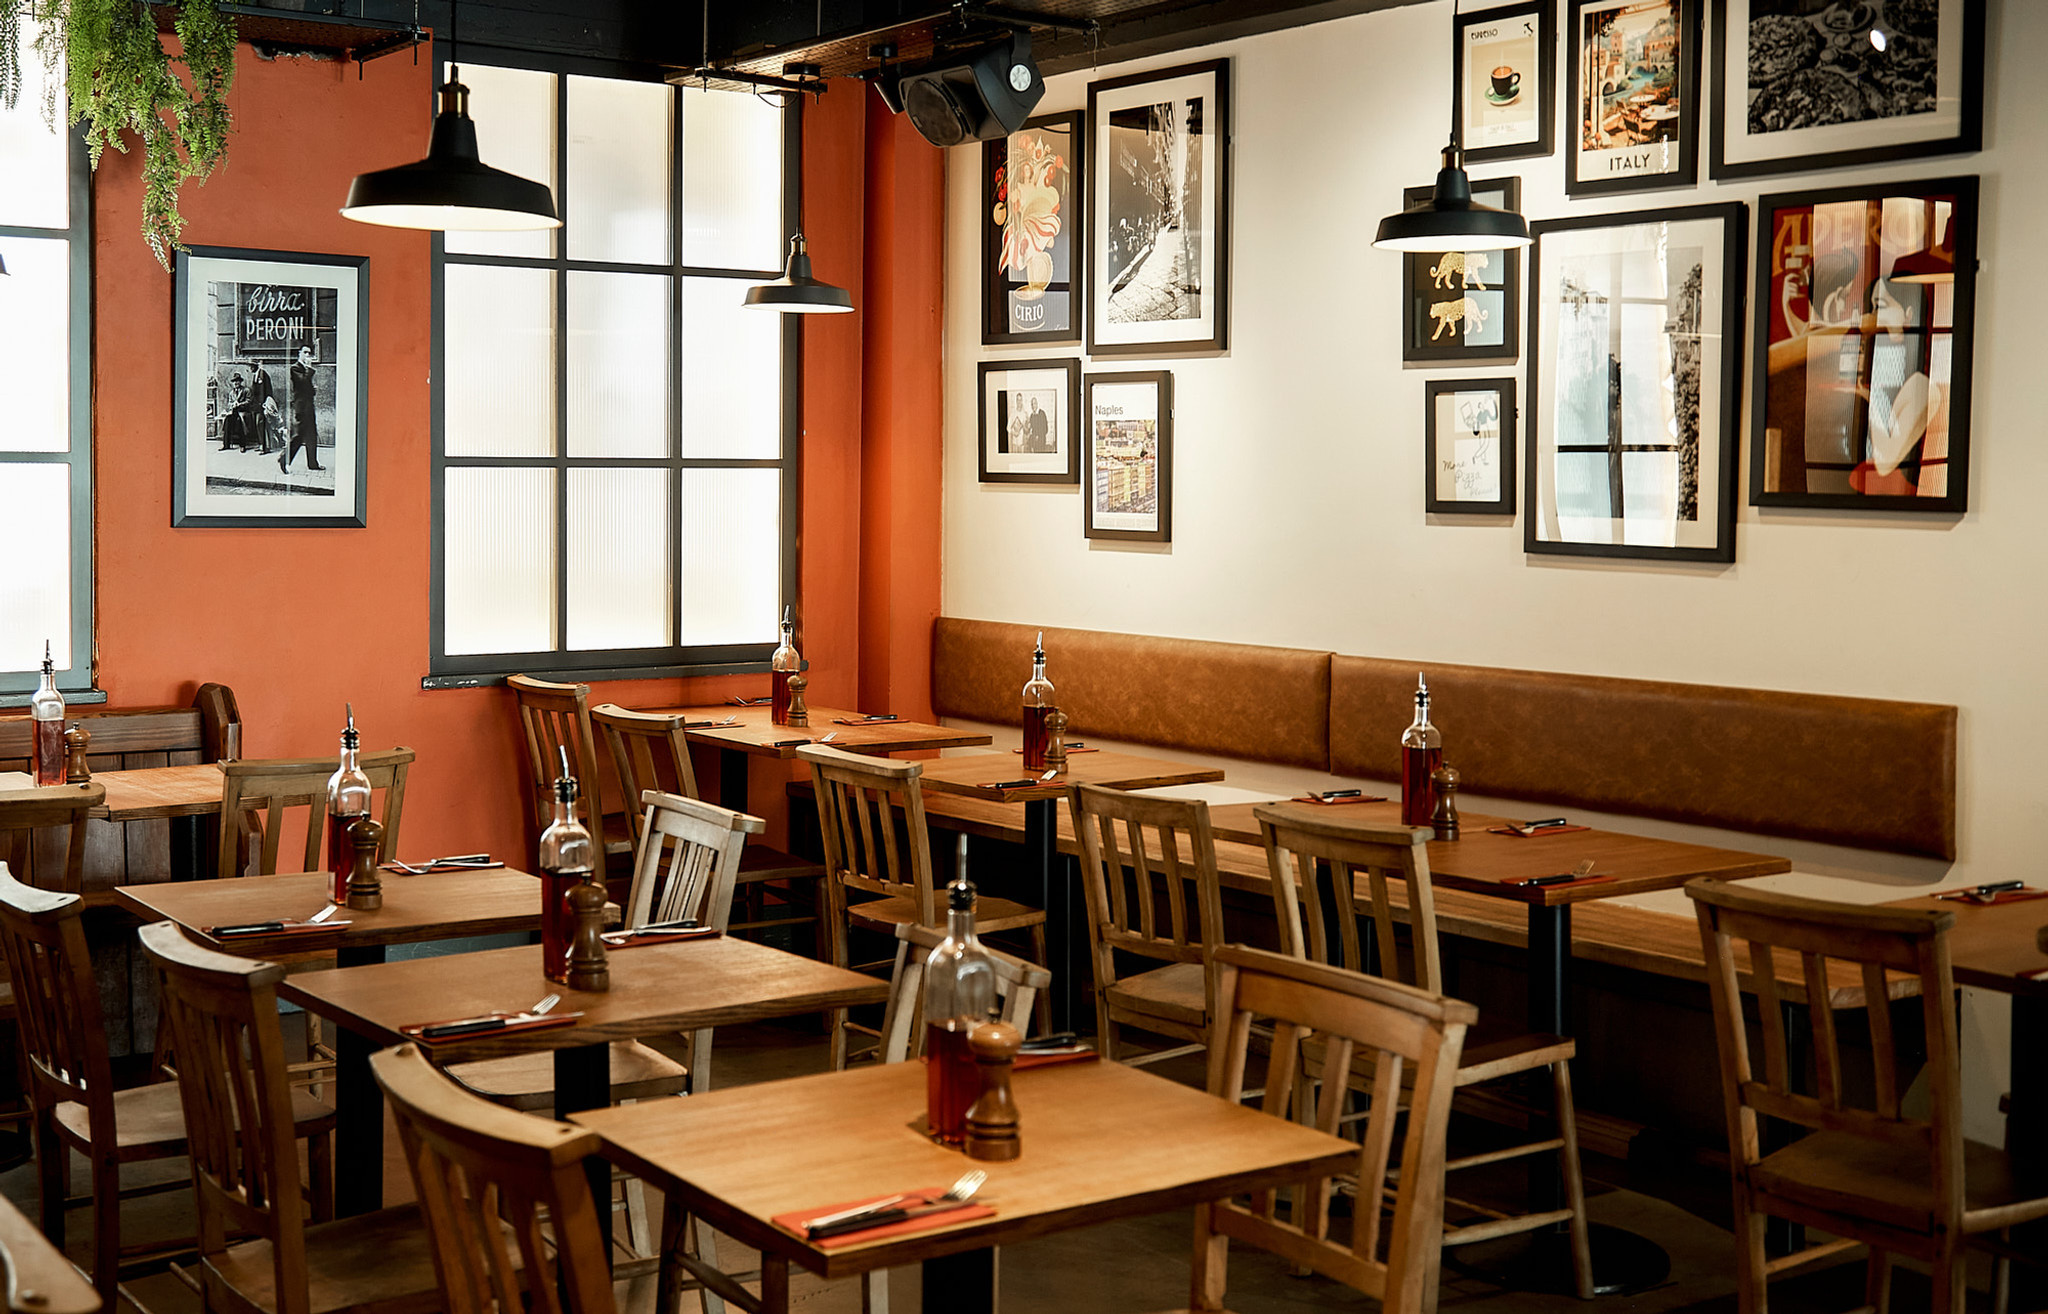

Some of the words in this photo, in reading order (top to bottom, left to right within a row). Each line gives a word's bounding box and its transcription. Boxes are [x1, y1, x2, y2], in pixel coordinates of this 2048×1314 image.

[1610, 154, 1650, 171] ITALY
[246, 286, 305, 313] birra
[1015, 304, 1044, 321] CIRIO
[246, 317, 304, 340] PERONI
[1095, 405, 1124, 417] Naples
